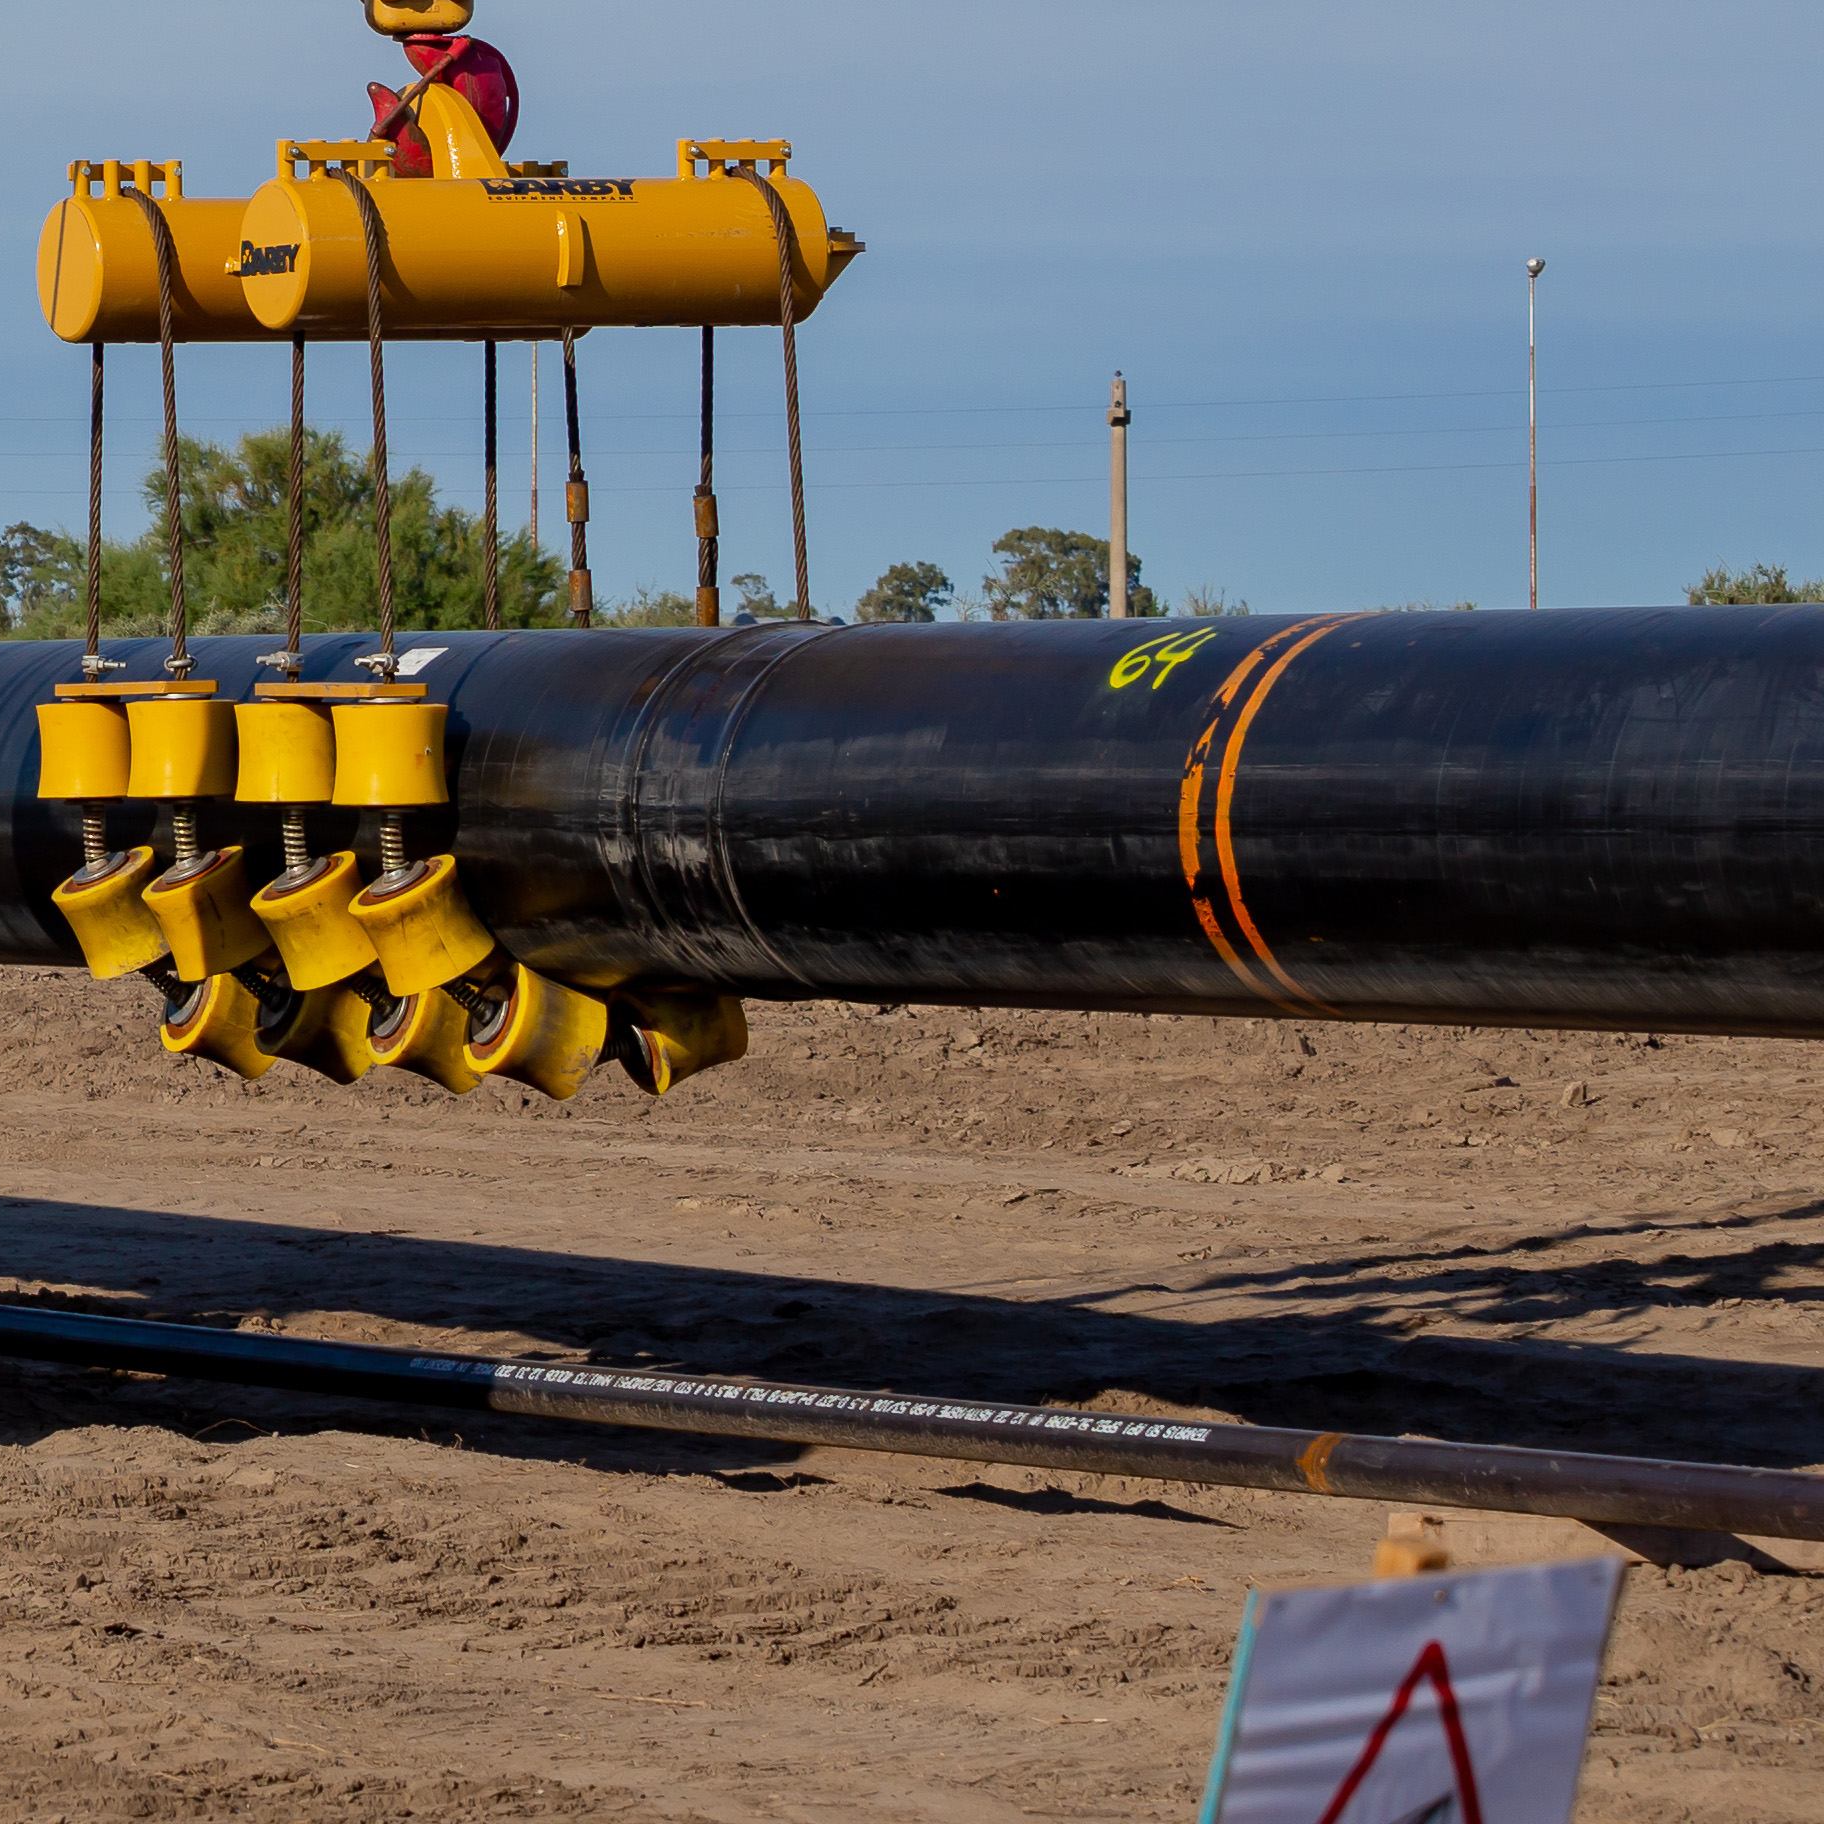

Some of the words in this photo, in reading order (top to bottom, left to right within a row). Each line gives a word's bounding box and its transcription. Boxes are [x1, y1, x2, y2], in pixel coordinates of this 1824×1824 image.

[477, 178, 637, 195] DARBY
[240, 240, 301, 277] DARBY
[1109, 626, 1218, 691] 64
